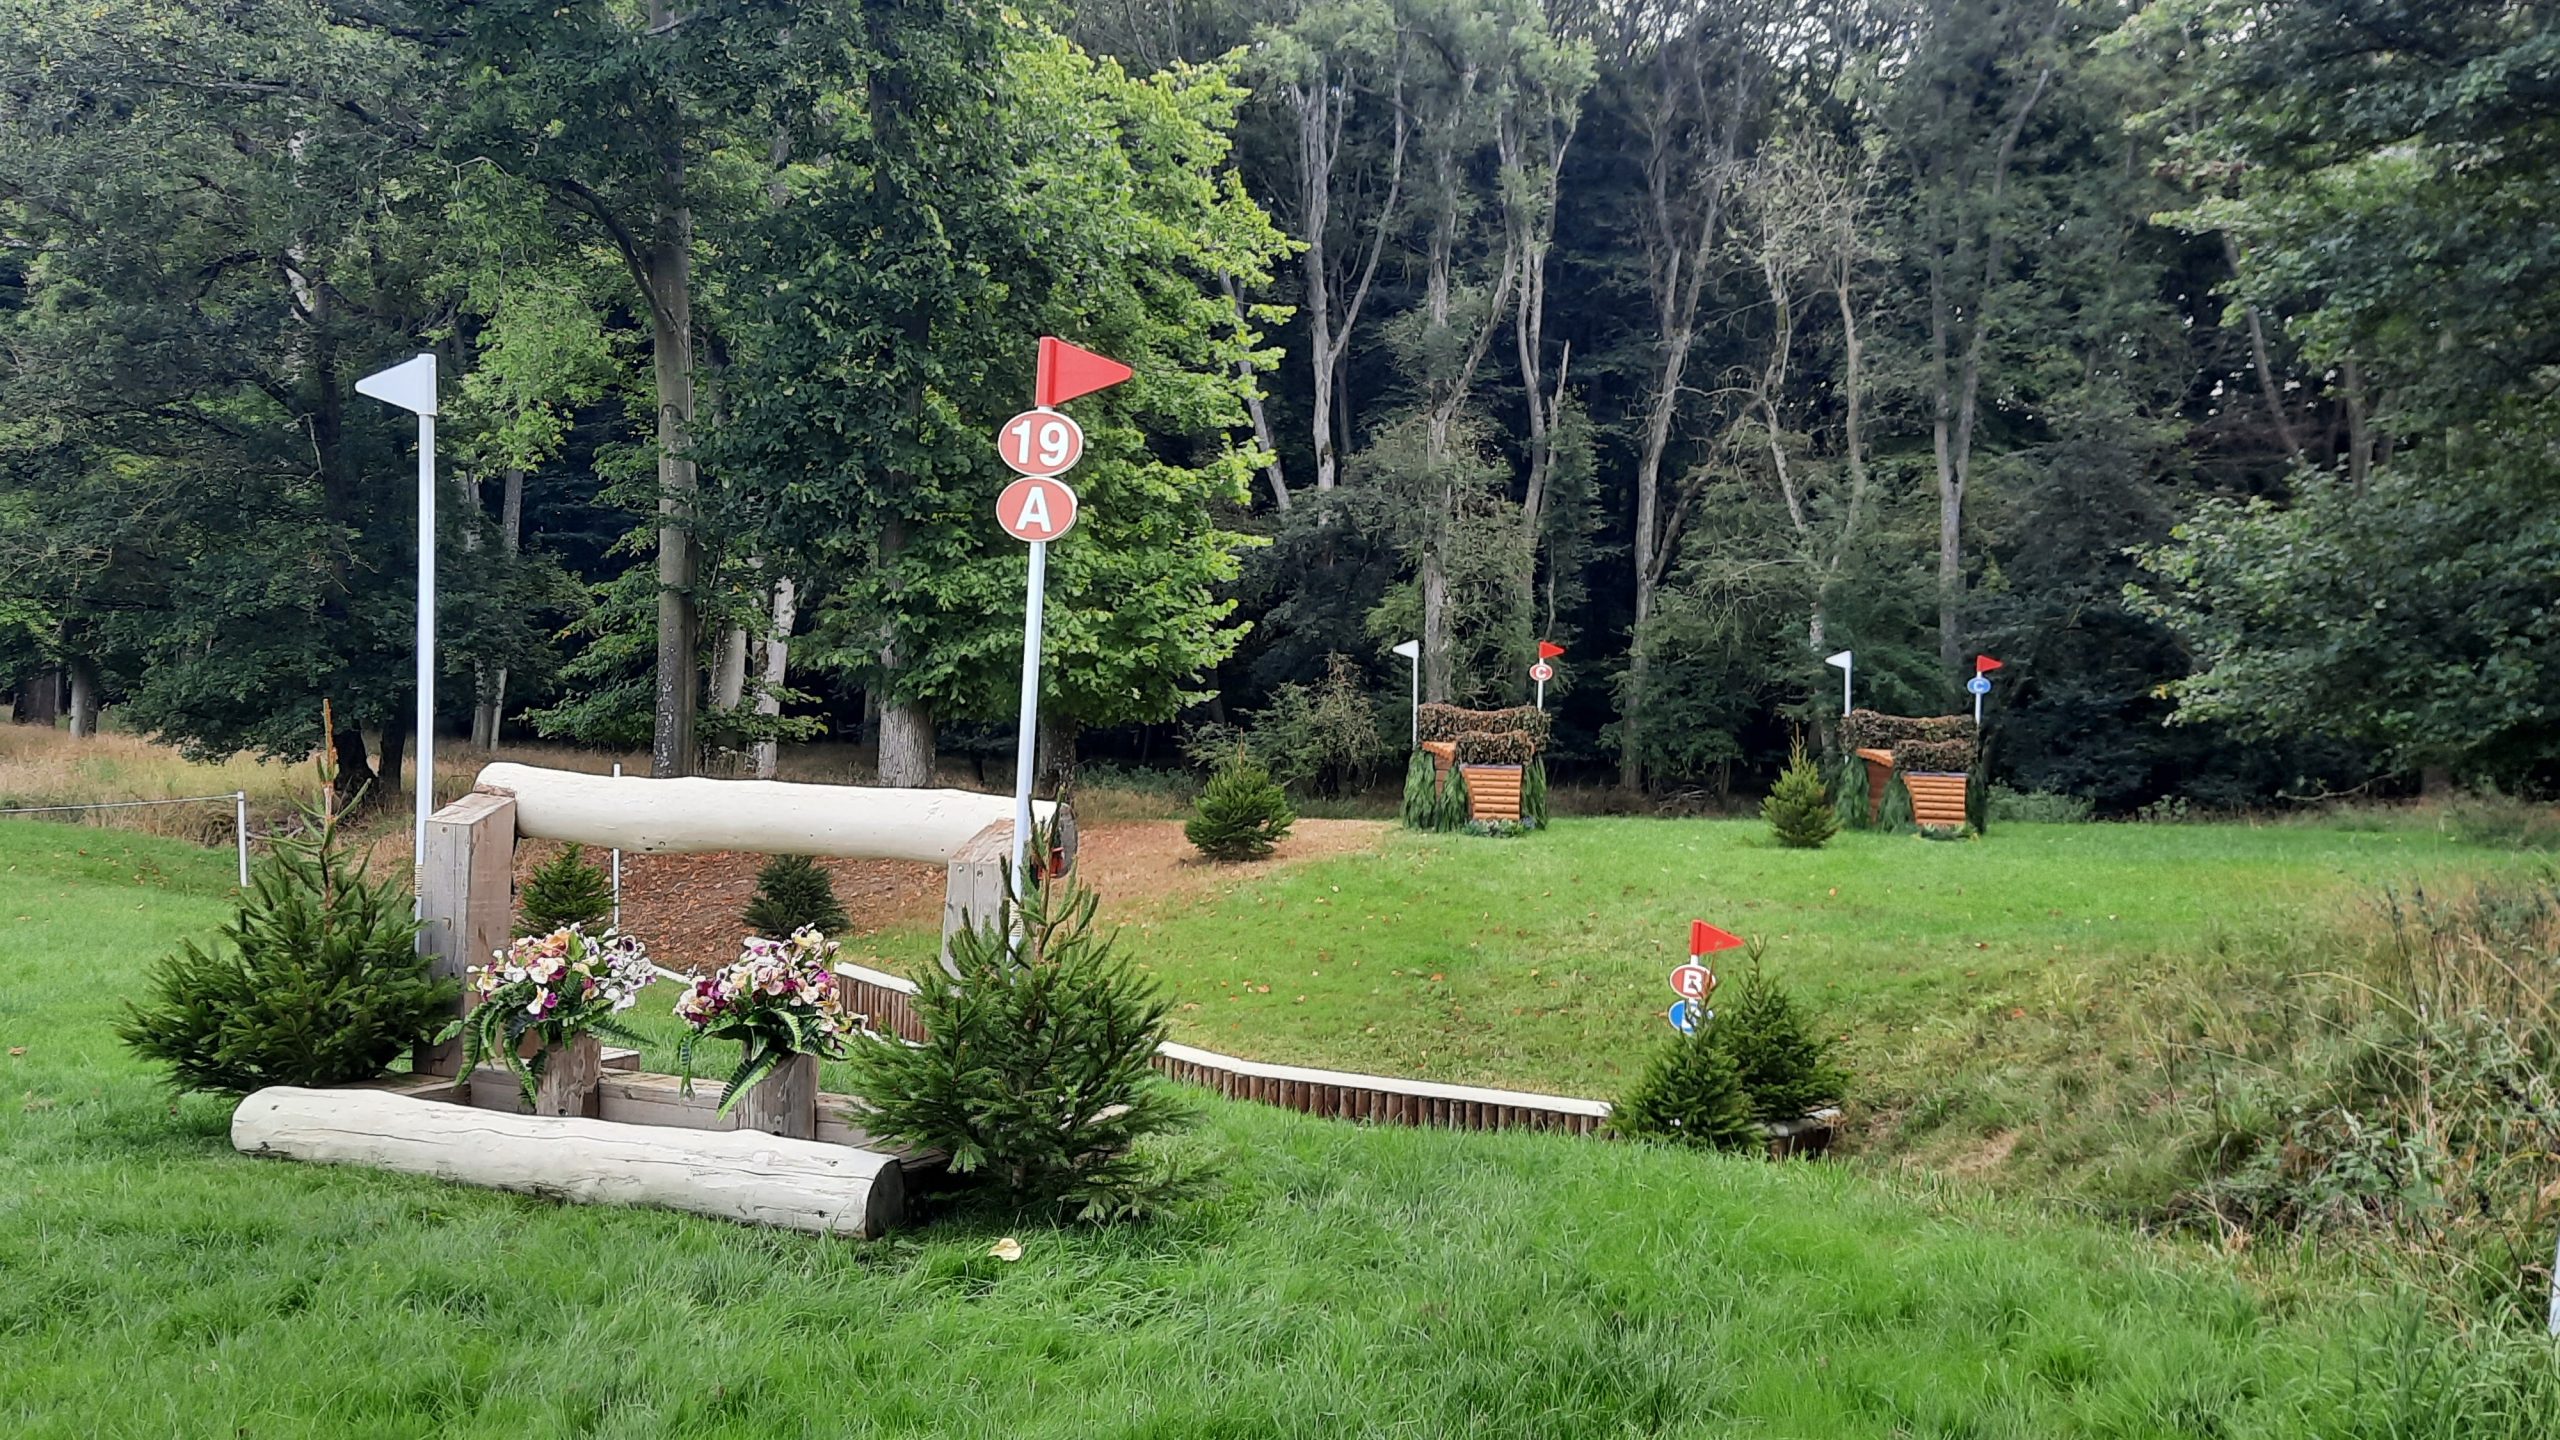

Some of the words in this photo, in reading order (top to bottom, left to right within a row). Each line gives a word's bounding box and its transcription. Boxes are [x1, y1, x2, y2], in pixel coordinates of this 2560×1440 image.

[1011, 420, 1069, 467] 19
[1015, 486, 1052, 532] A
[1535, 666, 1548, 679] C
[1973, 680, 1985, 692] C
